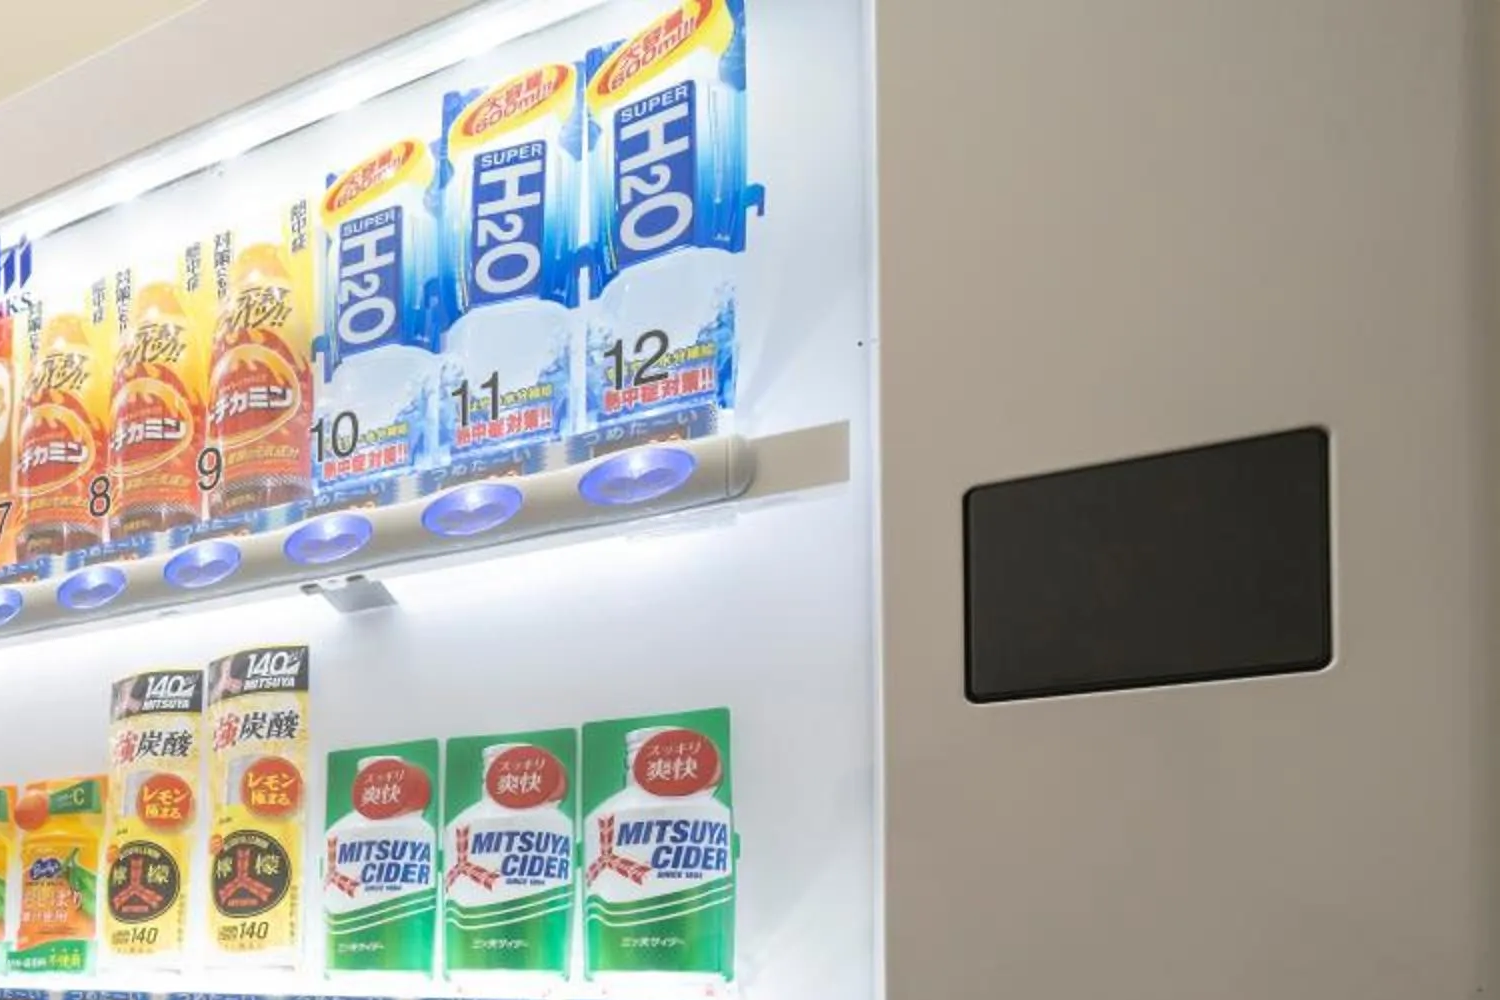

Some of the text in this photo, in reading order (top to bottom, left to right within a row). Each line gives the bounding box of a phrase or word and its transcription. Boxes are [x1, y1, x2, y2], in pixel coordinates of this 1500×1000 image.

[621, 84, 689, 122] SUPER
[481, 143, 543, 168] SUPER
[619, 102, 694, 252] H2O
[342, 211, 396, 236] SUPER
[475, 159, 541, 294] H2O
[338, 224, 396, 346] H2O
[604, 330, 669, 390] 12
[452, 371, 498, 427] 11
[311, 411, 359, 463] 10
[198, 448, 222, 490] 9
[89, 475, 111, 516] 8
[247, 651, 288, 678] 140
[145, 675, 182, 699] 140
[243, 677, 296, 690] MITSUYA
[142, 699, 190, 711] MITSUYA
[247, 772, 297, 791] レモン
[646, 757, 698, 782] 爽快
[143, 786, 189, 803] レモン
[497, 772, 542, 795] 爽快
[470, 830, 571, 856] MITSUYA
[615, 819, 729, 848] MITSUYA
[338, 840, 431, 865] MITSUYA
[650, 844, 729, 872] CIDER
[361, 861, 431, 887] CIDER
[500, 853, 570, 880] CIDER
[131, 927, 159, 945] 140
[238, 921, 269, 939] 140
